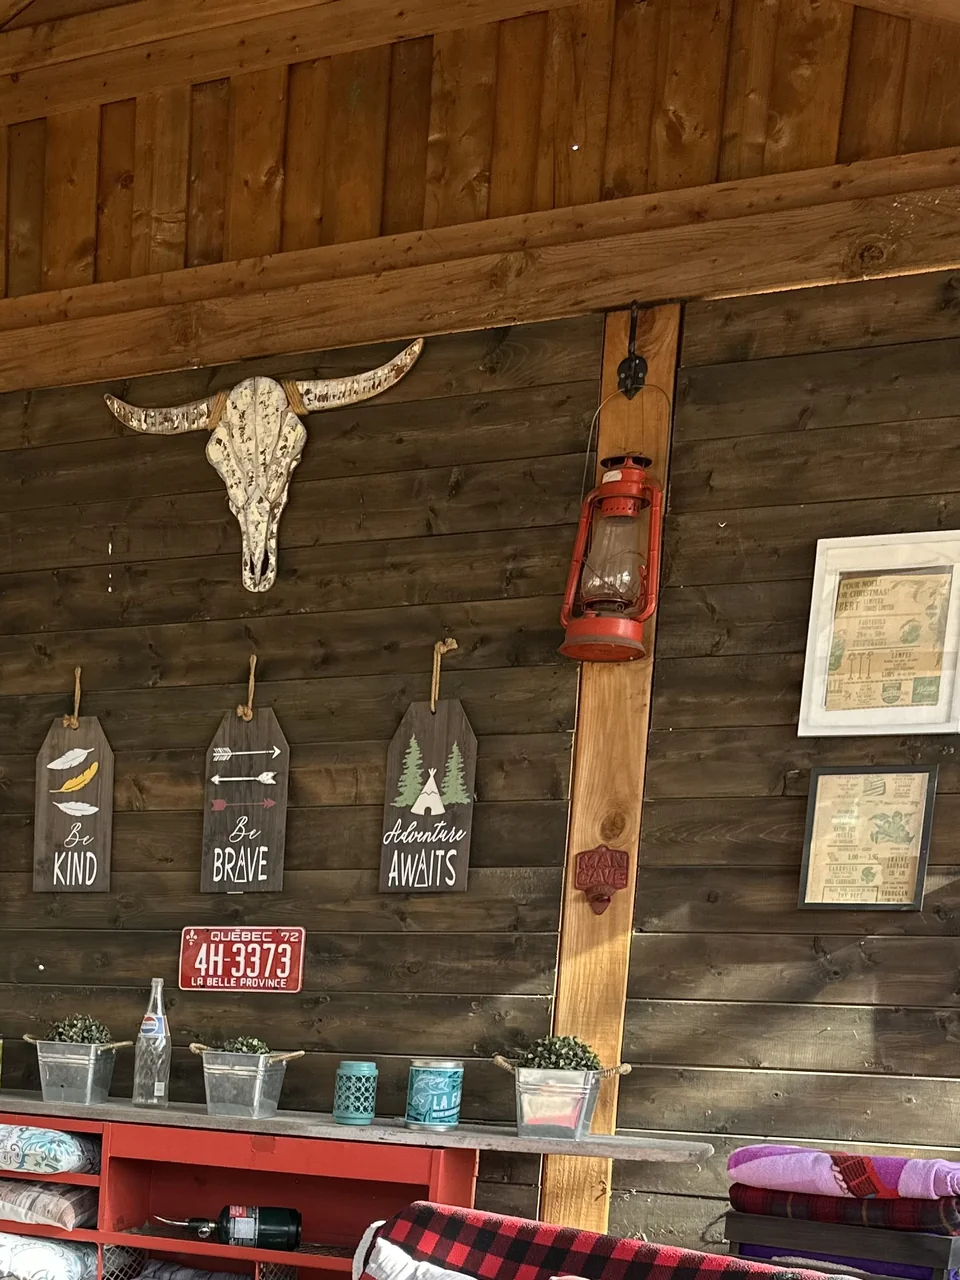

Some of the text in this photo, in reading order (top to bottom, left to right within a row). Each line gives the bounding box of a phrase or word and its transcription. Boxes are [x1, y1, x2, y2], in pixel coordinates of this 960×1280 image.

[63, 822, 94, 848] Be
[228, 815, 261, 843] Be
[382, 818, 467, 845] Adventure
[53, 851, 98, 886] KIND
[212, 845, 269, 883] BRAVE
[388, 848, 458, 888] AWAITS
[210, 928, 300, 942] QUÉBEC 72
[194, 943, 292, 978] 4H-3373
[191, 977, 287, 988] LA BELLE PROVINCE
[433, 1095, 448, 1110] LA
